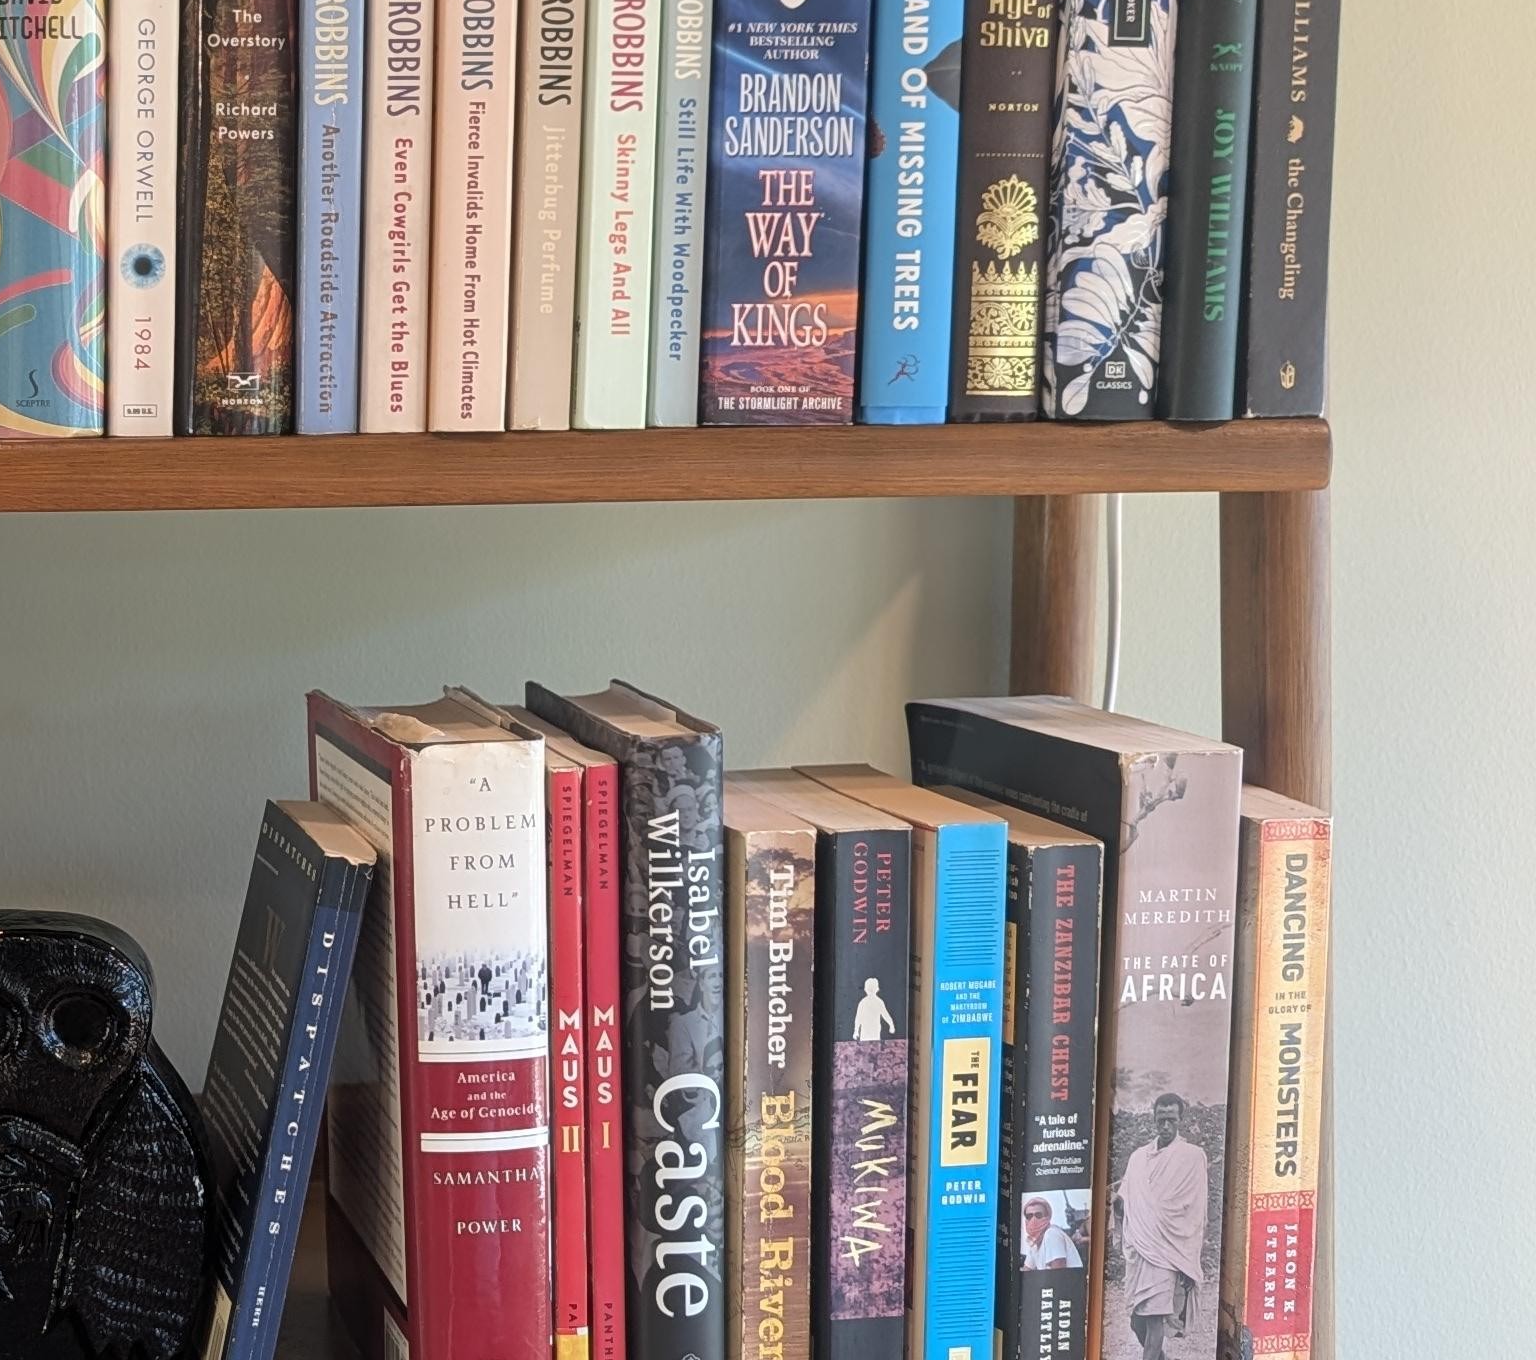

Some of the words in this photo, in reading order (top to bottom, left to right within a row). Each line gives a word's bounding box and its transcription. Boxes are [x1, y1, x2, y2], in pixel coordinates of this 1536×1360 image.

[207, 34, 285, 50] Overstory
[232, 10, 262, 23] The
[137, 19, 156, 119] GEORGE
[739, 73, 842, 114] BRANDON
[901, 68, 927, 110] OF
[393, 138, 413, 183] Even
[724, 117, 854, 157] SANDERSON
[136, 130, 155, 222] ORWELL
[759, 169, 814, 207] THE
[895, 122, 926, 238] MISSING
[388, 191, 412, 274] Cowgirls
[745, 212, 818, 258] WAY
[392, 280, 410, 314] Get
[763, 261, 798, 298] OF
[893, 250, 922, 331] TREES
[134, 316, 151, 370] 1984
[391, 321, 410, 352] the
[730, 302, 828, 348] KINGS
[390, 361, 408, 413] Blues
[647, 809, 684, 1011] Wilkerson
[687, 847, 719, 970] Isabel
[1055, 864, 1075, 907] THE
[1052, 917, 1074, 1025] ZANZIBAR
[1120, 972, 1227, 1003] AFRICA
[1123, 956, 1152, 970] THE
[1161, 955, 1199, 969] FATE
[1209, 954, 1228, 967] OF
[558, 1009, 580, 1109] MAUS
[593, 1005, 614, 1104] MAUS
[1050, 1034, 1070, 1101] CHEST
[267, 930, 336, 1236] DISPATCHES
[950, 1073, 979, 1151] FEAR
[433, 1169, 541, 1185] SAMANTHA
[760, 1089, 795, 1223] Blood
[653, 1071, 722, 1319] Caste
[839, 1098, 898, 1268] MUKIWA
[457, 1219, 522, 1235] POWER
